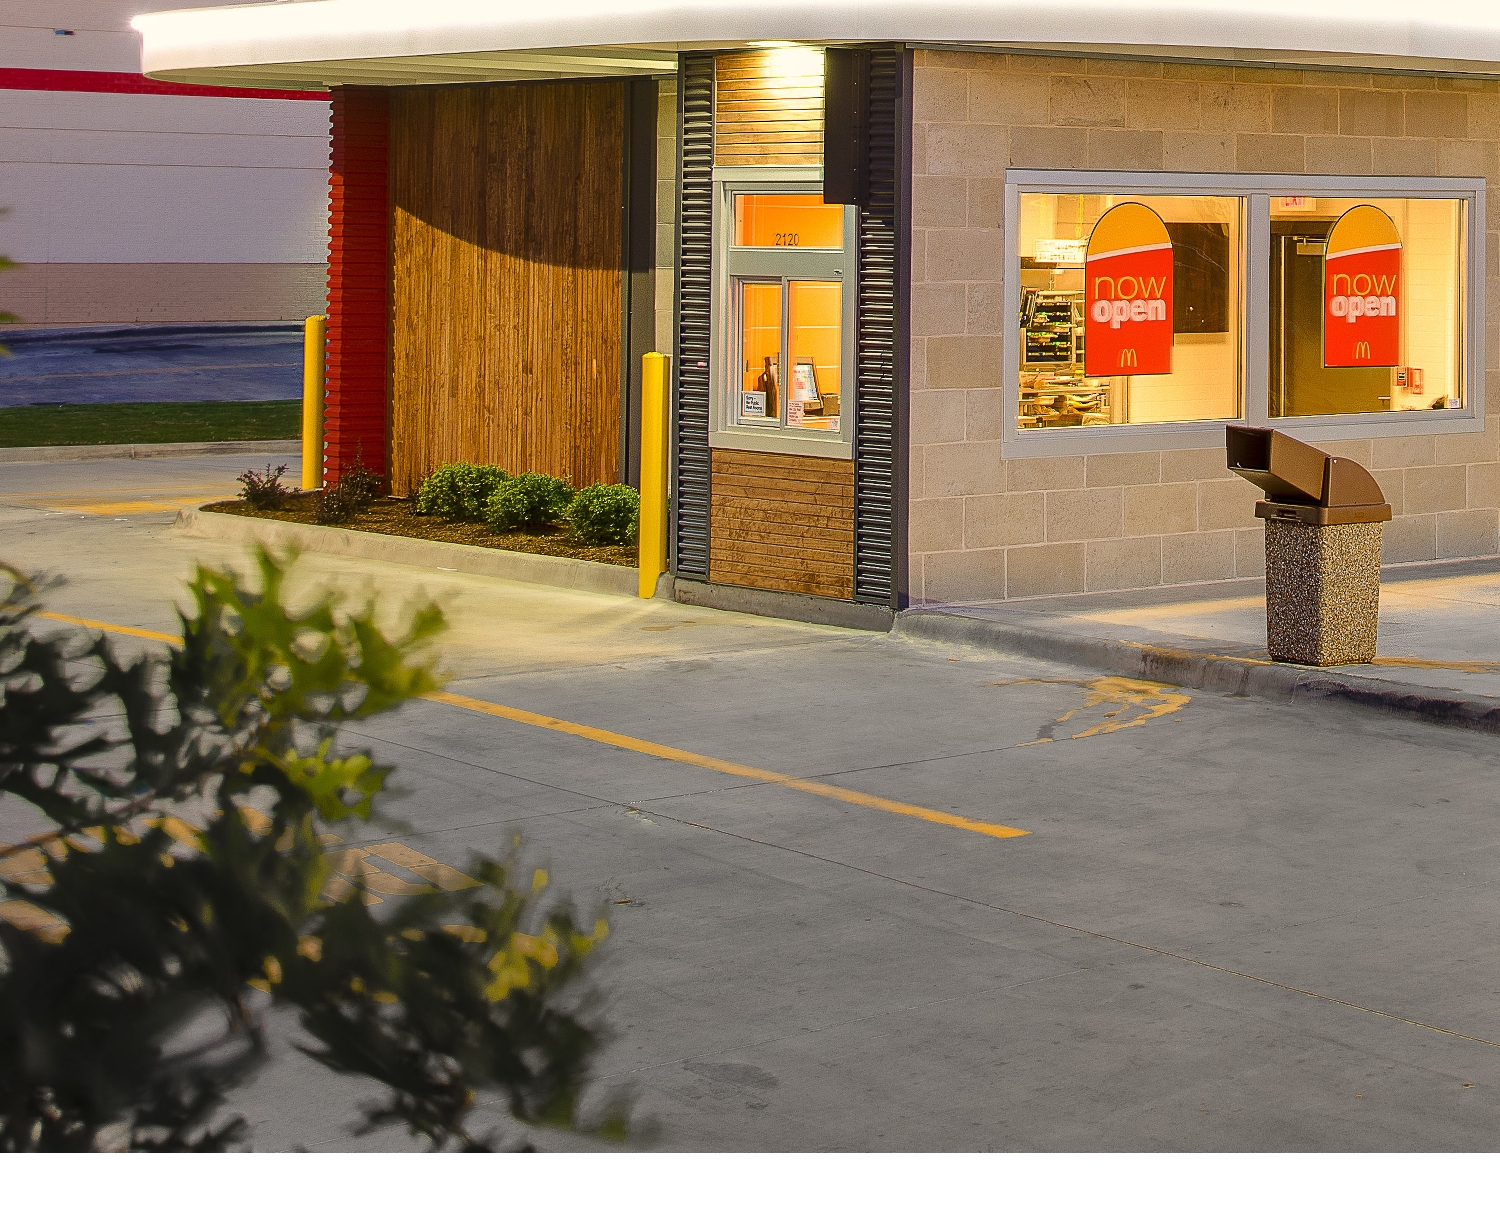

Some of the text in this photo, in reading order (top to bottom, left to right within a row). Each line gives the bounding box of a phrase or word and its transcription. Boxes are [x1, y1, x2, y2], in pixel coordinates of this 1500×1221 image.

[775, 233, 800, 246] 2120
[1094, 275, 1167, 300] now
[1333, 273, 1397, 296] now
[1091, 299, 1167, 329] open
[1329, 295, 1397, 324] open
